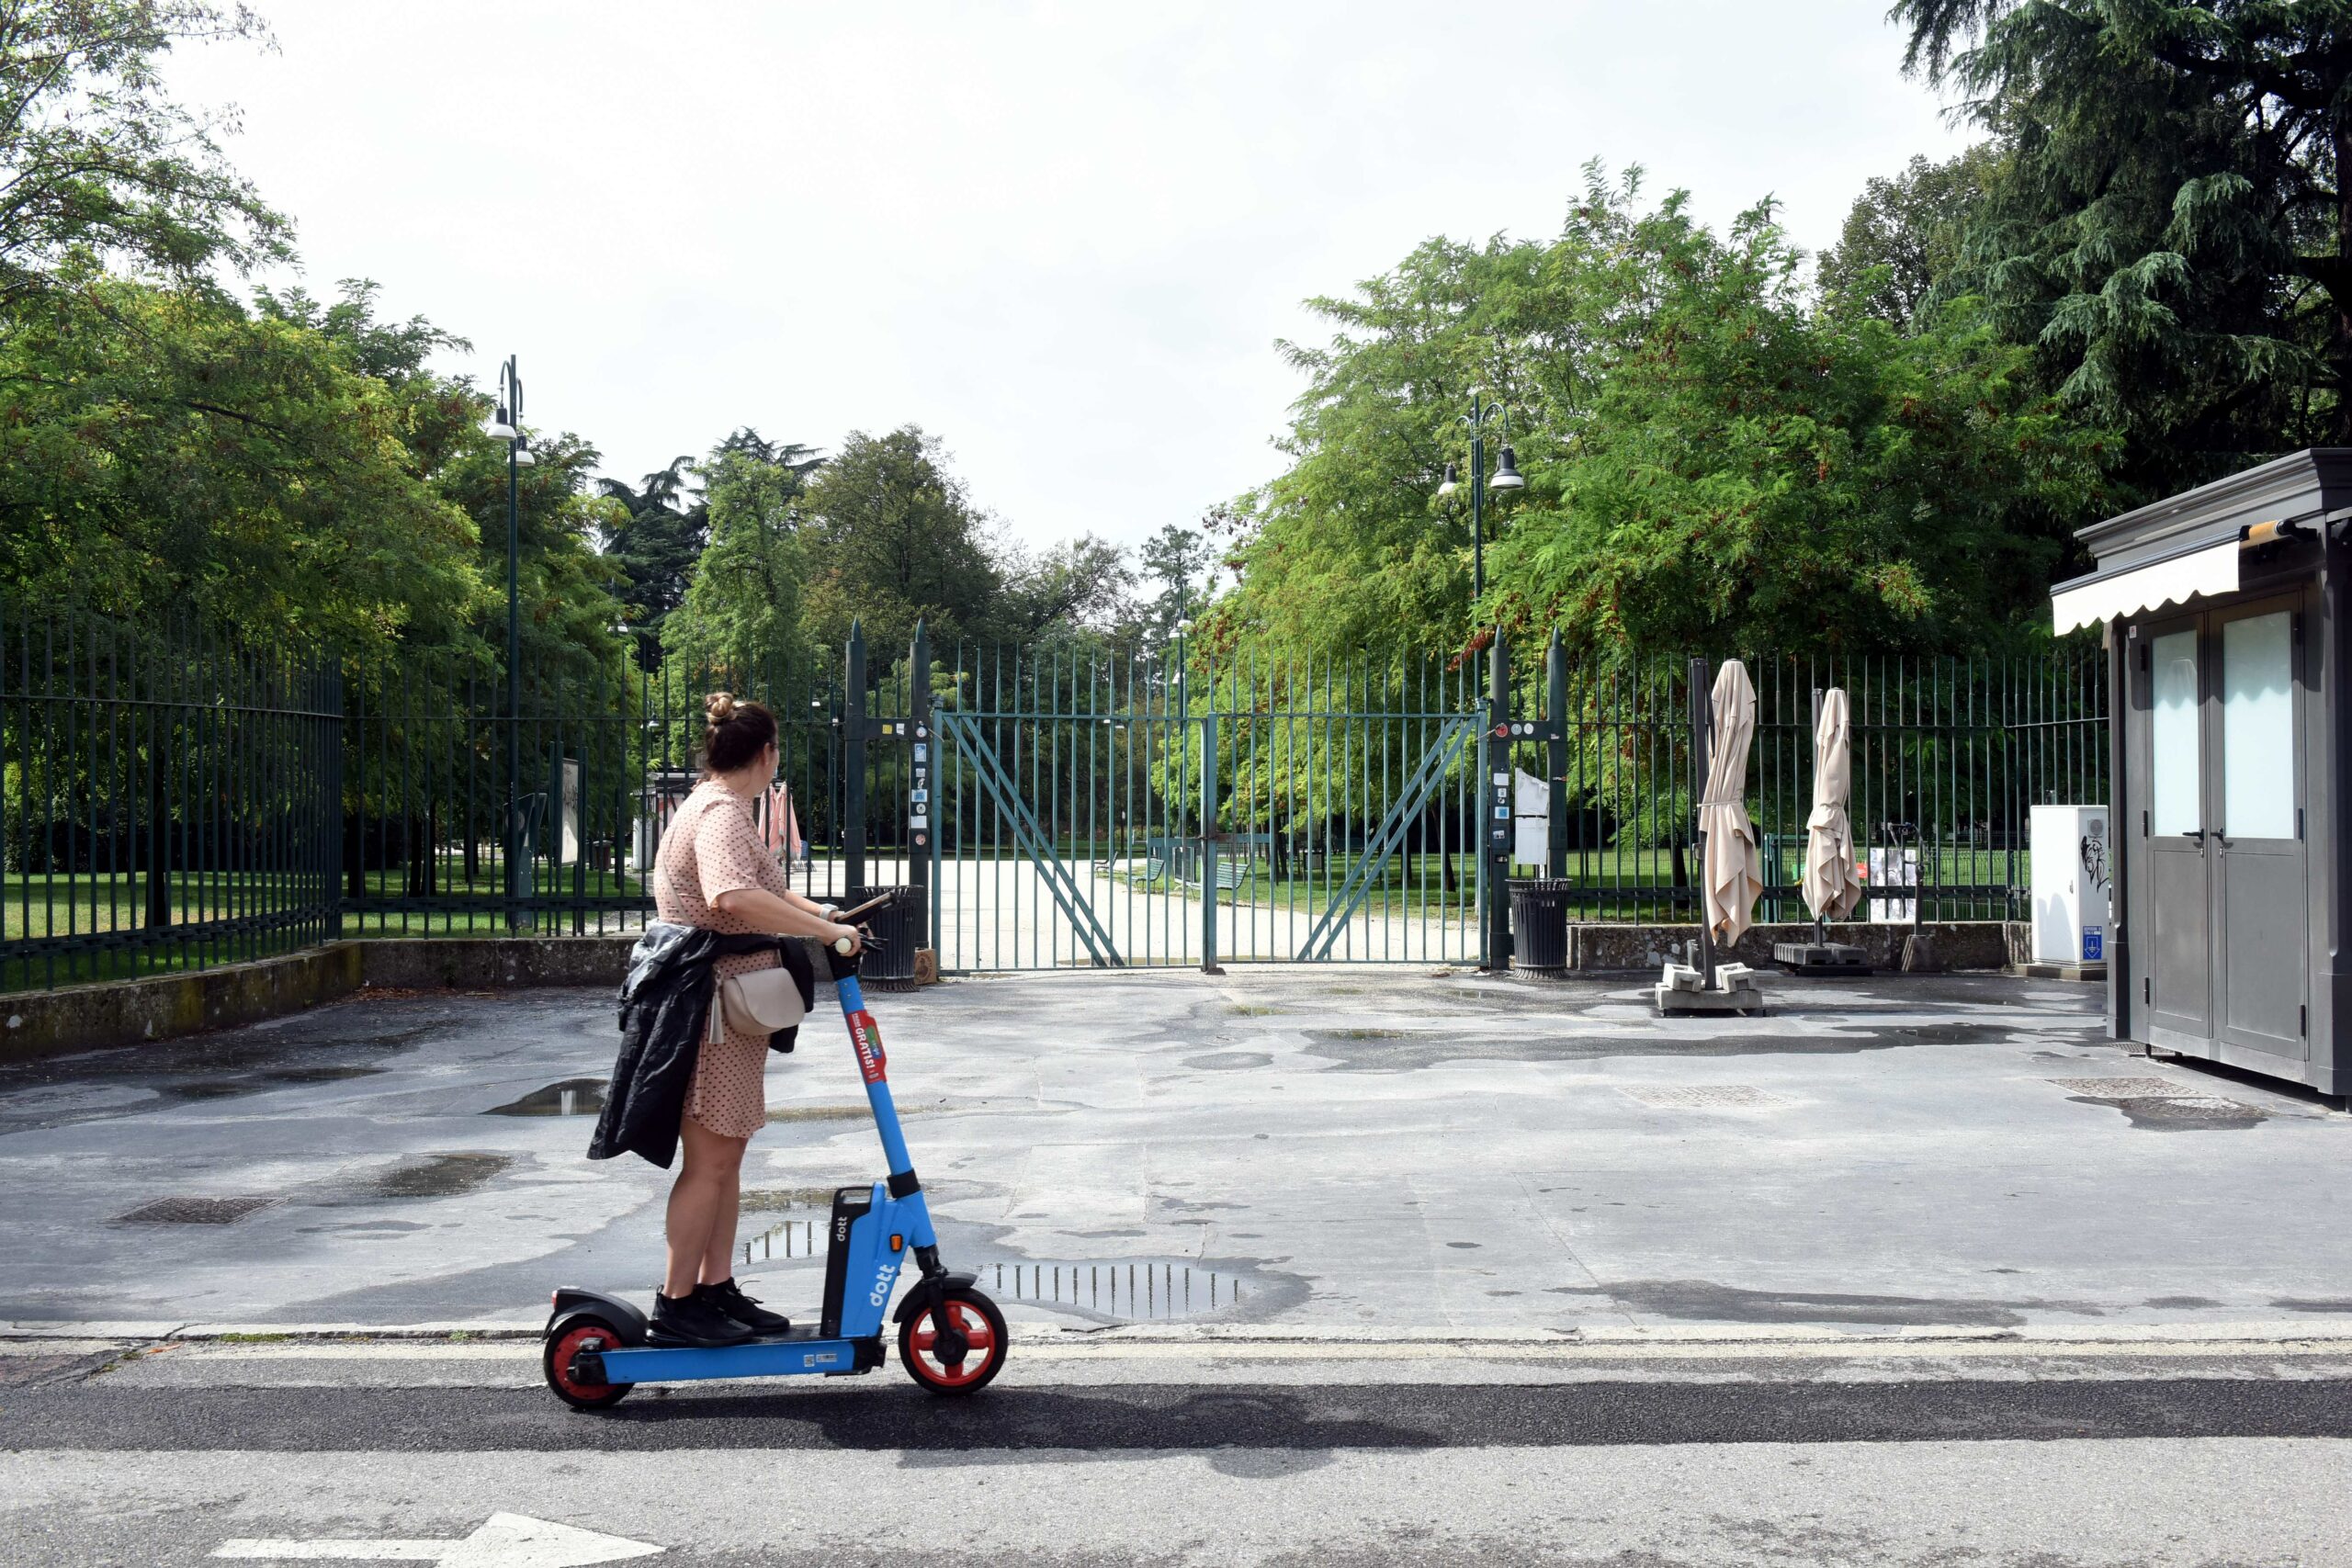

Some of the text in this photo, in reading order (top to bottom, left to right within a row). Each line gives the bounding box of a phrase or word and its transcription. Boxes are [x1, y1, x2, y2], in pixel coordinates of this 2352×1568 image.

[855, 1027, 876, 1068] GRATIS!
[836, 1216, 848, 1242] dott
[869, 1264, 896, 1307] dott
